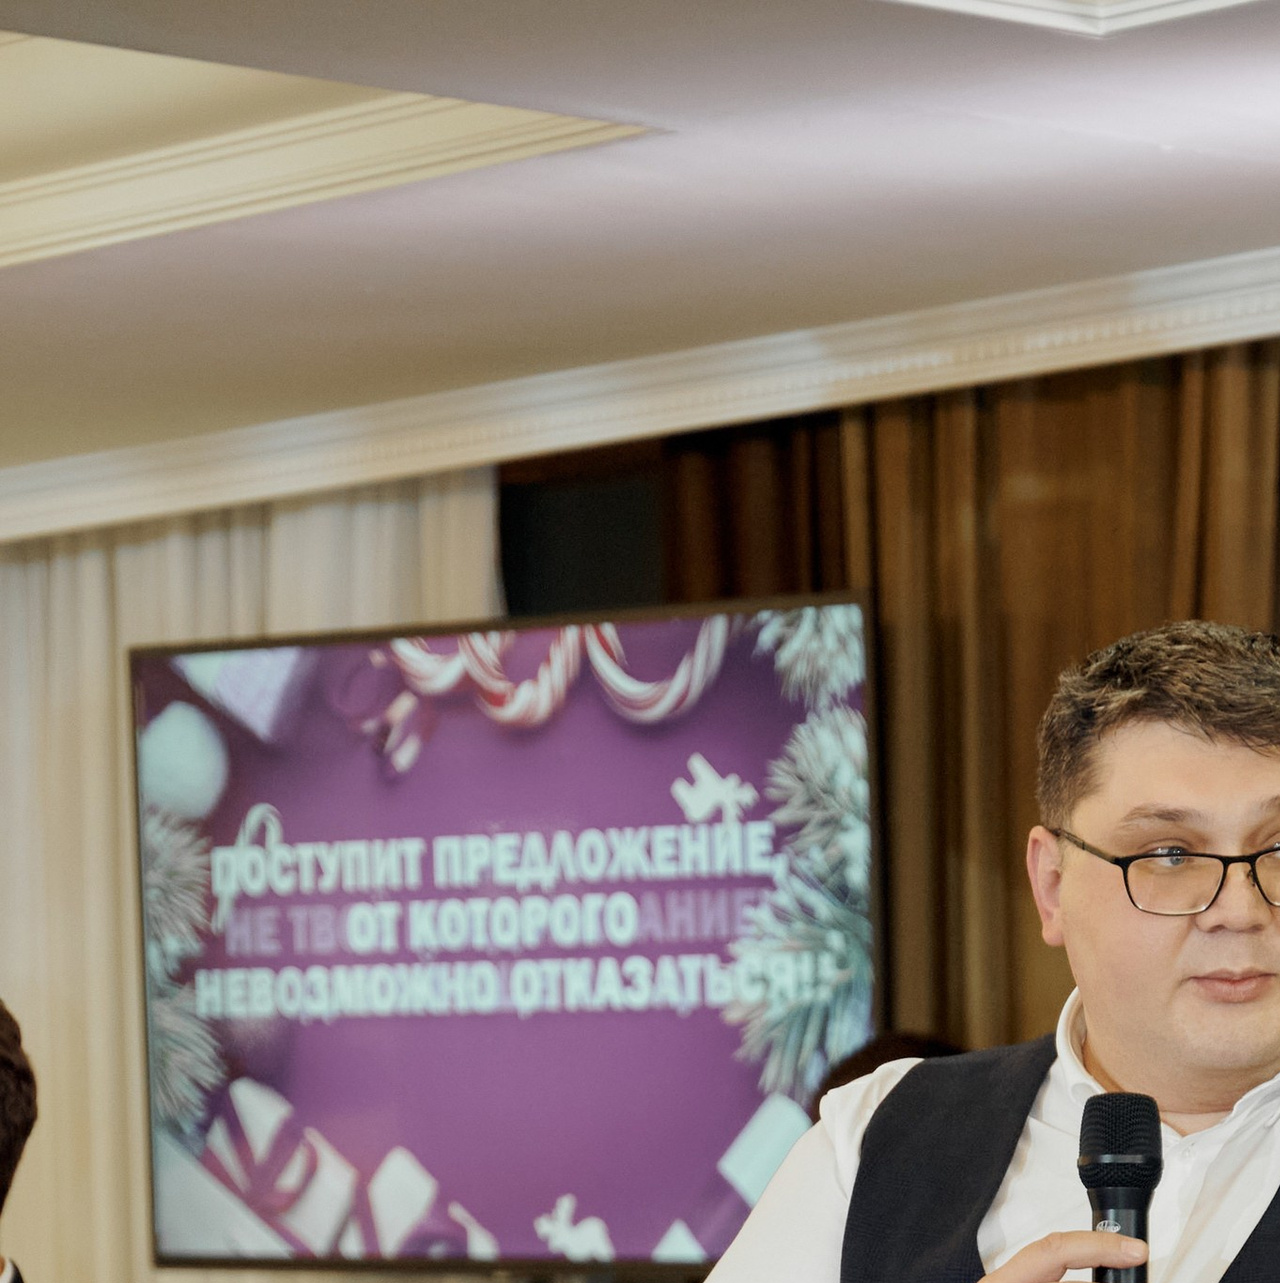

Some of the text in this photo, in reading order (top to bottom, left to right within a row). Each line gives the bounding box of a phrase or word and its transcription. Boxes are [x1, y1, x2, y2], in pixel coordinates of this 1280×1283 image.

[211, 837, 425, 898] ПОСТУПИТ
[408, 891, 640, 953] КОТОРОГО
[195, 956, 499, 1020] НЕВОЗМОЖНО
